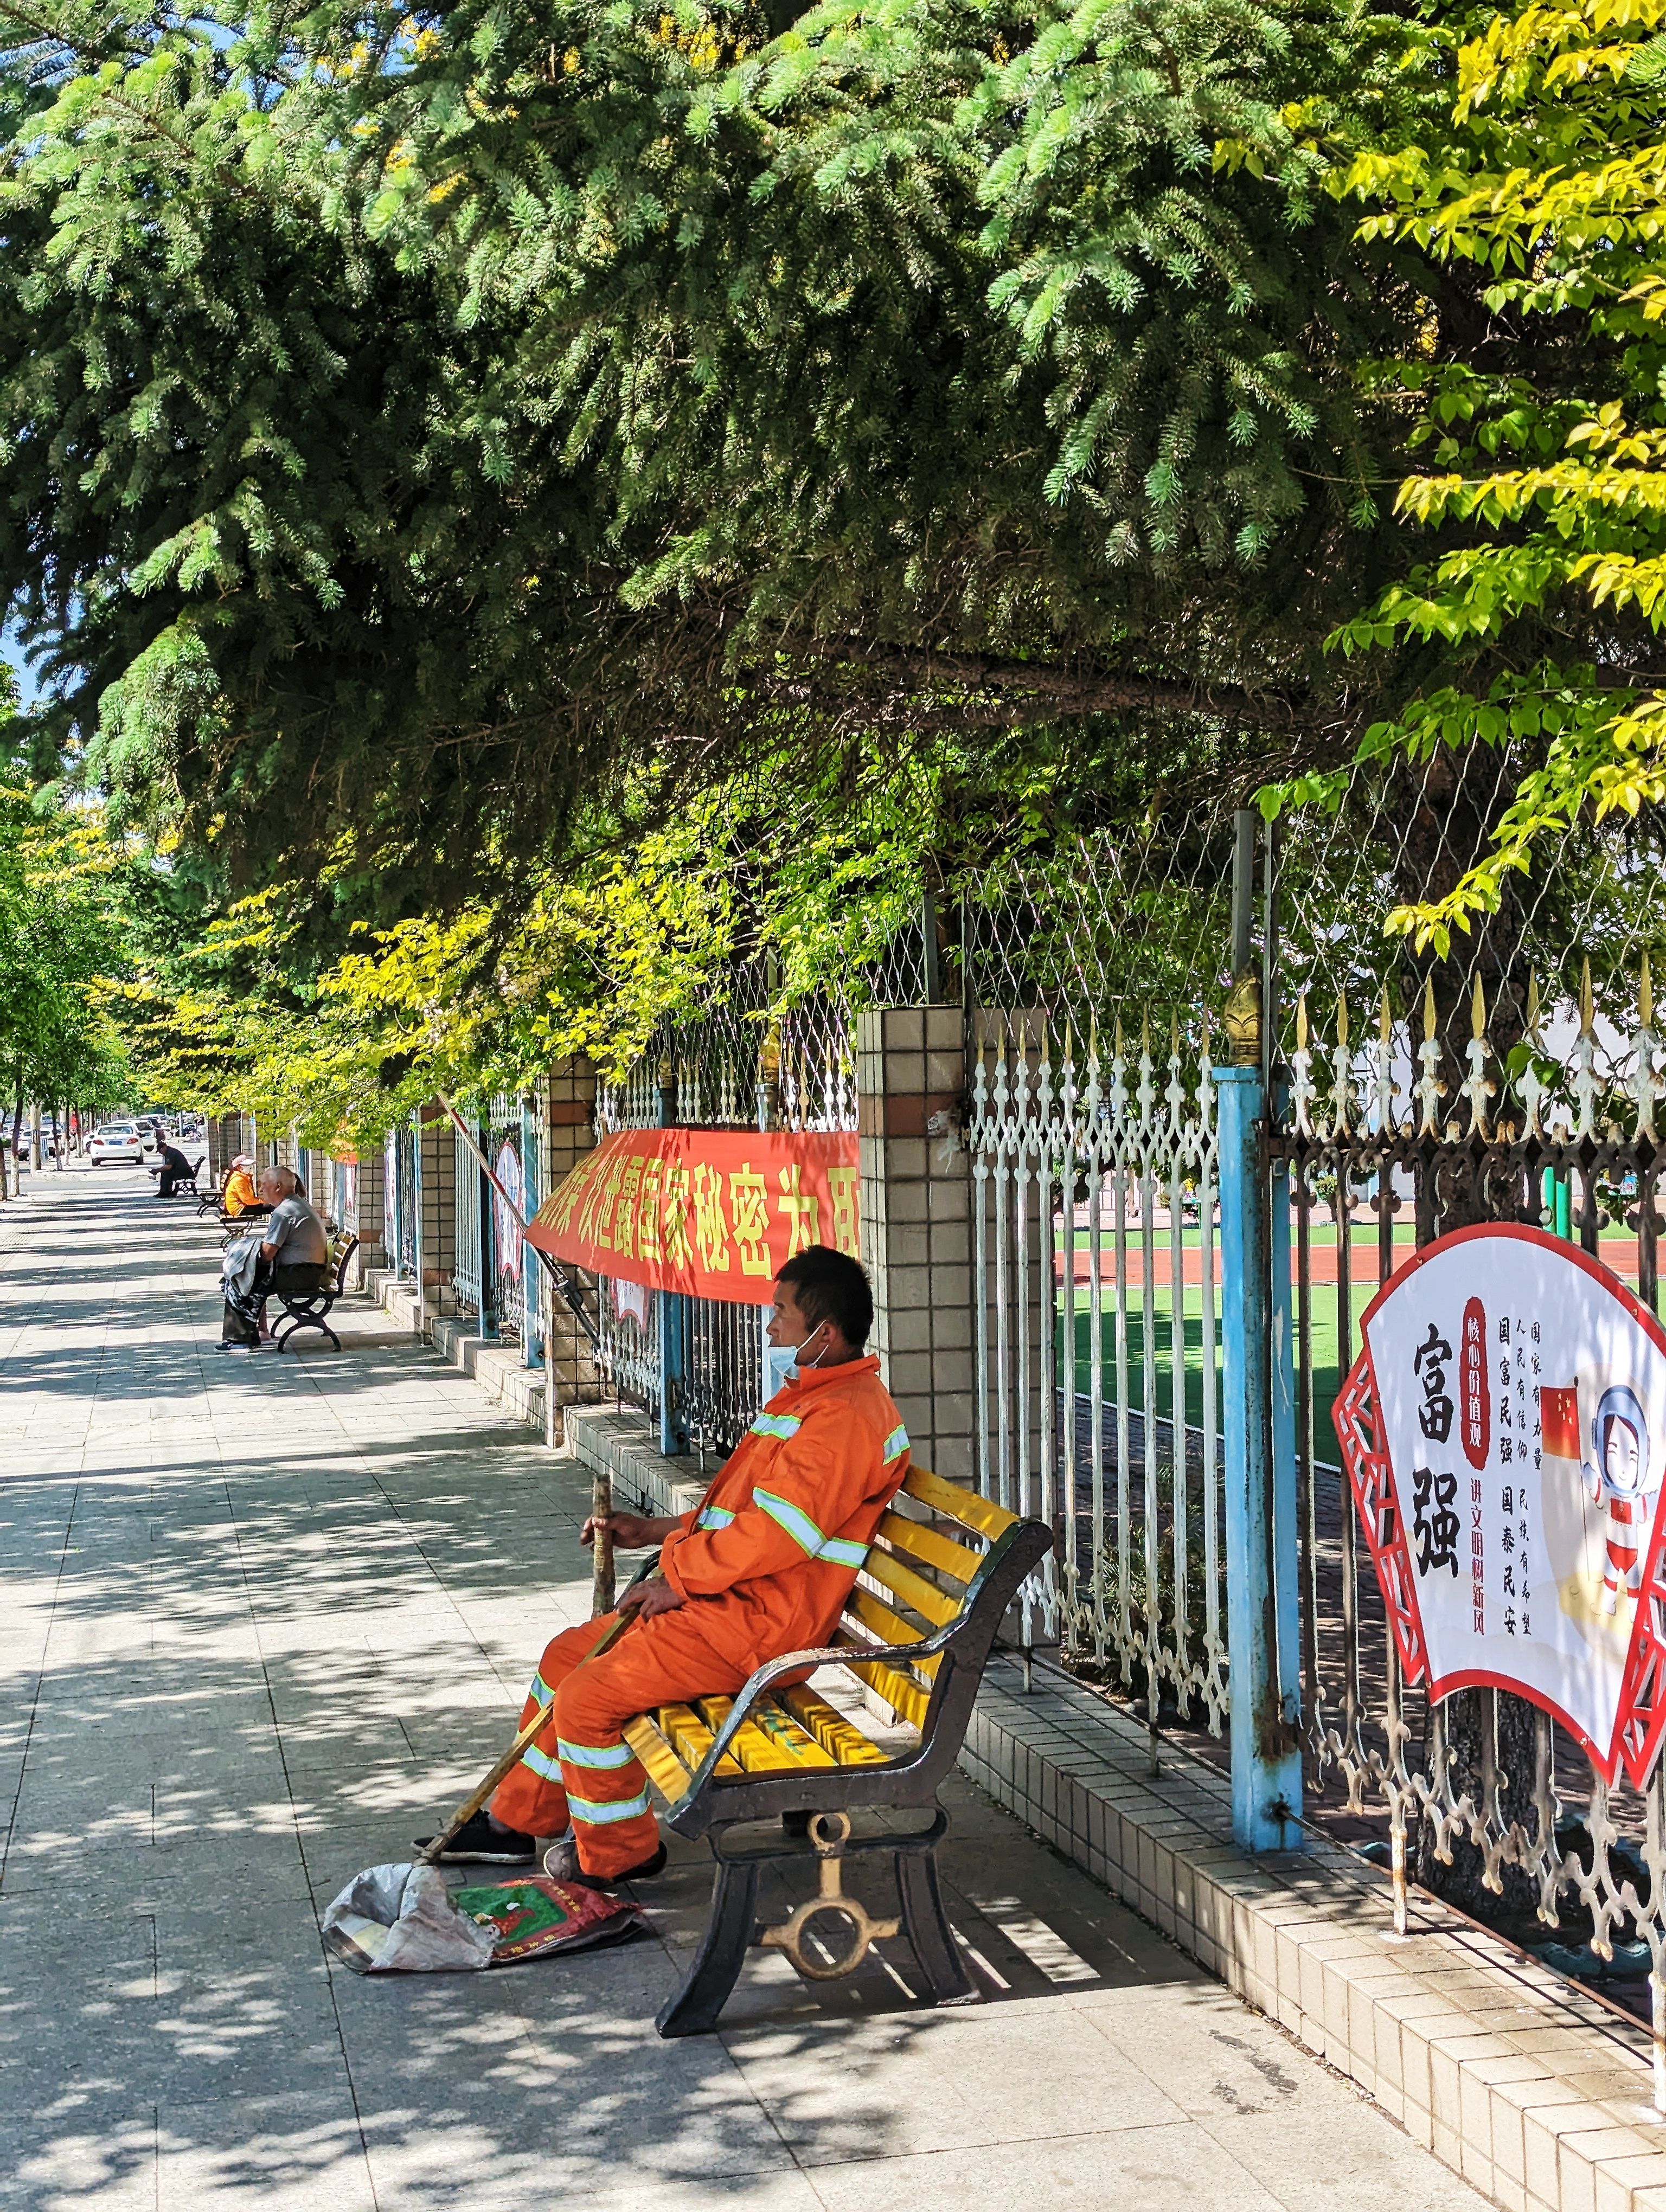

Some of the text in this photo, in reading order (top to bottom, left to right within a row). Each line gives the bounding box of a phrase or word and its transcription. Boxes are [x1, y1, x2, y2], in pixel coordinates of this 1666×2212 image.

[1412, 1322, 1460, 1578] 富强
[1467, 1317, 1482, 1448] 核心价值观
[1498, 1316, 1513, 1464] 国富民强
[1516, 1319, 1528, 1463] 人民有信仰
[1530, 1321, 1542, 1470] 国家有力量
[1470, 1477, 1485, 1636] 讲文明树新风
[1501, 1486, 1516, 1636] 国泰民安
[1518, 1488, 1532, 1636] 民族有希望
